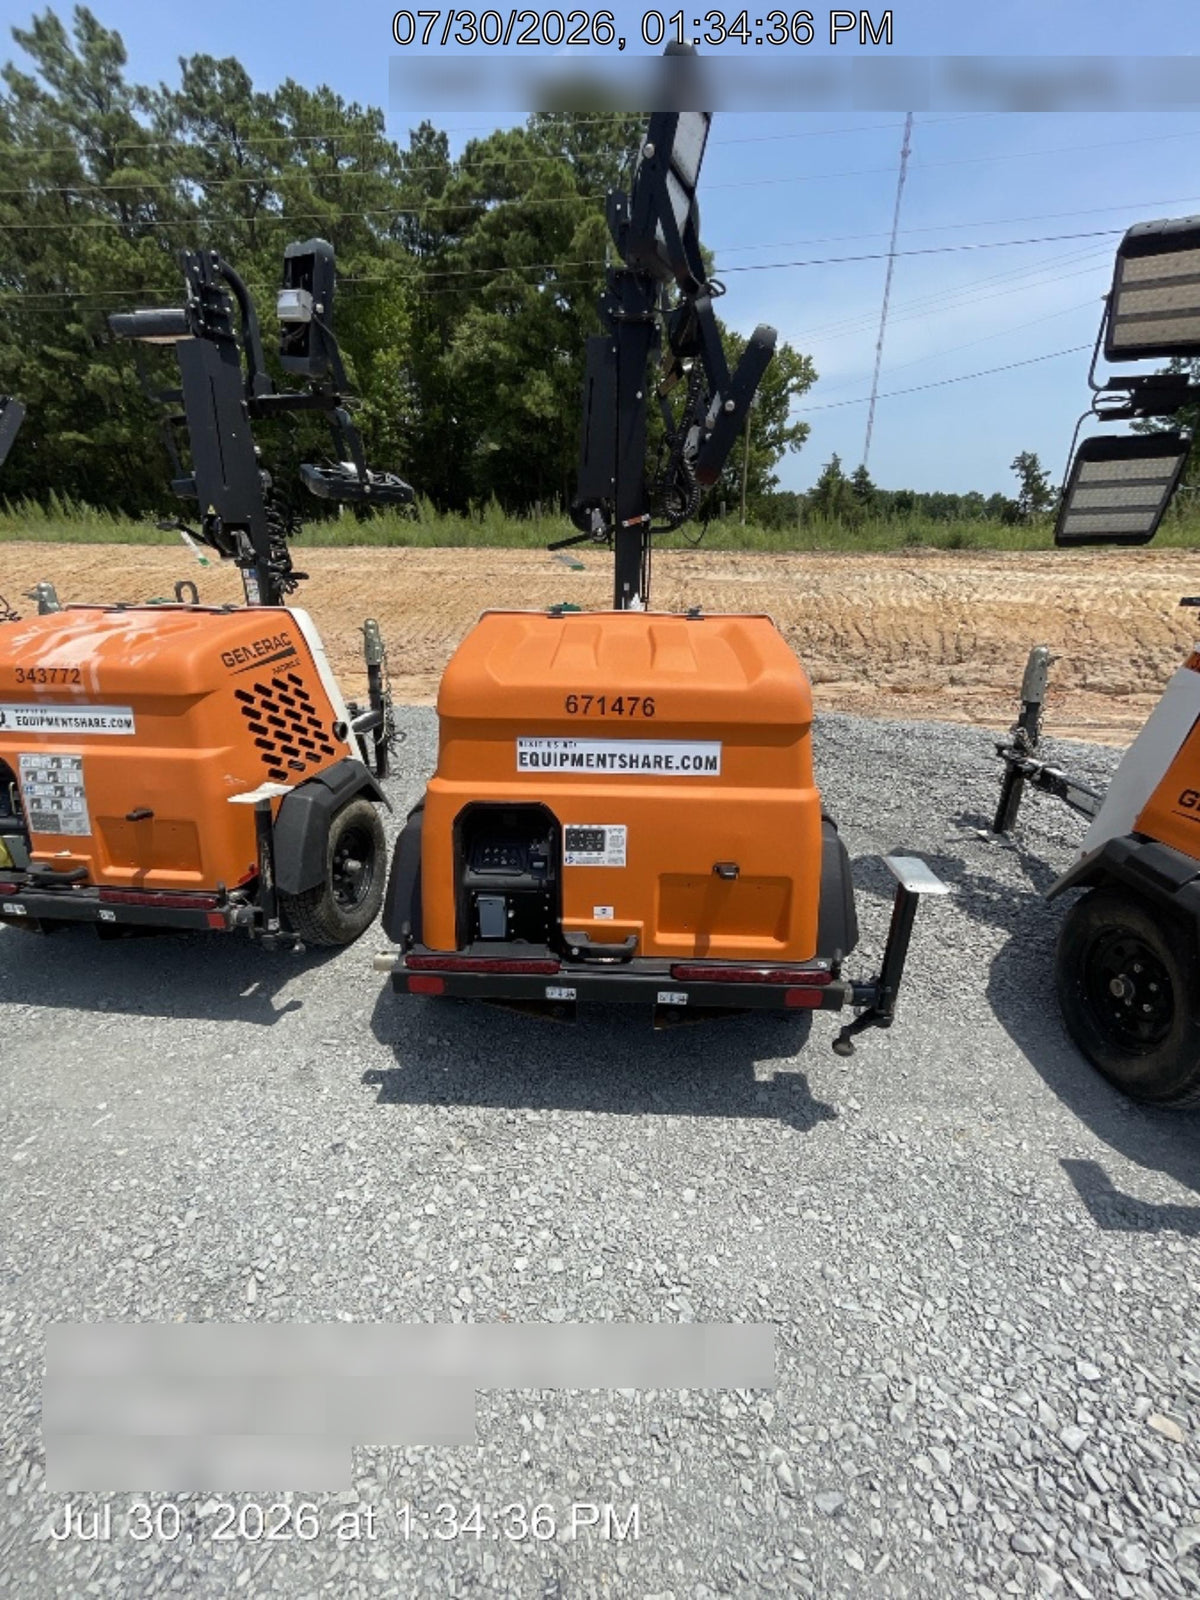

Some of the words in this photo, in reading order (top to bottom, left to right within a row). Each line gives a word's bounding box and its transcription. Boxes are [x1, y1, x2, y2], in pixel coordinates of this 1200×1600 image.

[221, 632, 292, 668] GENERAC
[15, 668, 81, 684] 343772
[565, 695, 655, 717] 671476
[15, 715, 132, 728] EQUIPMENTSHARE.COM
[518, 751, 718, 771] EQUIPMENTSHARE.COM
